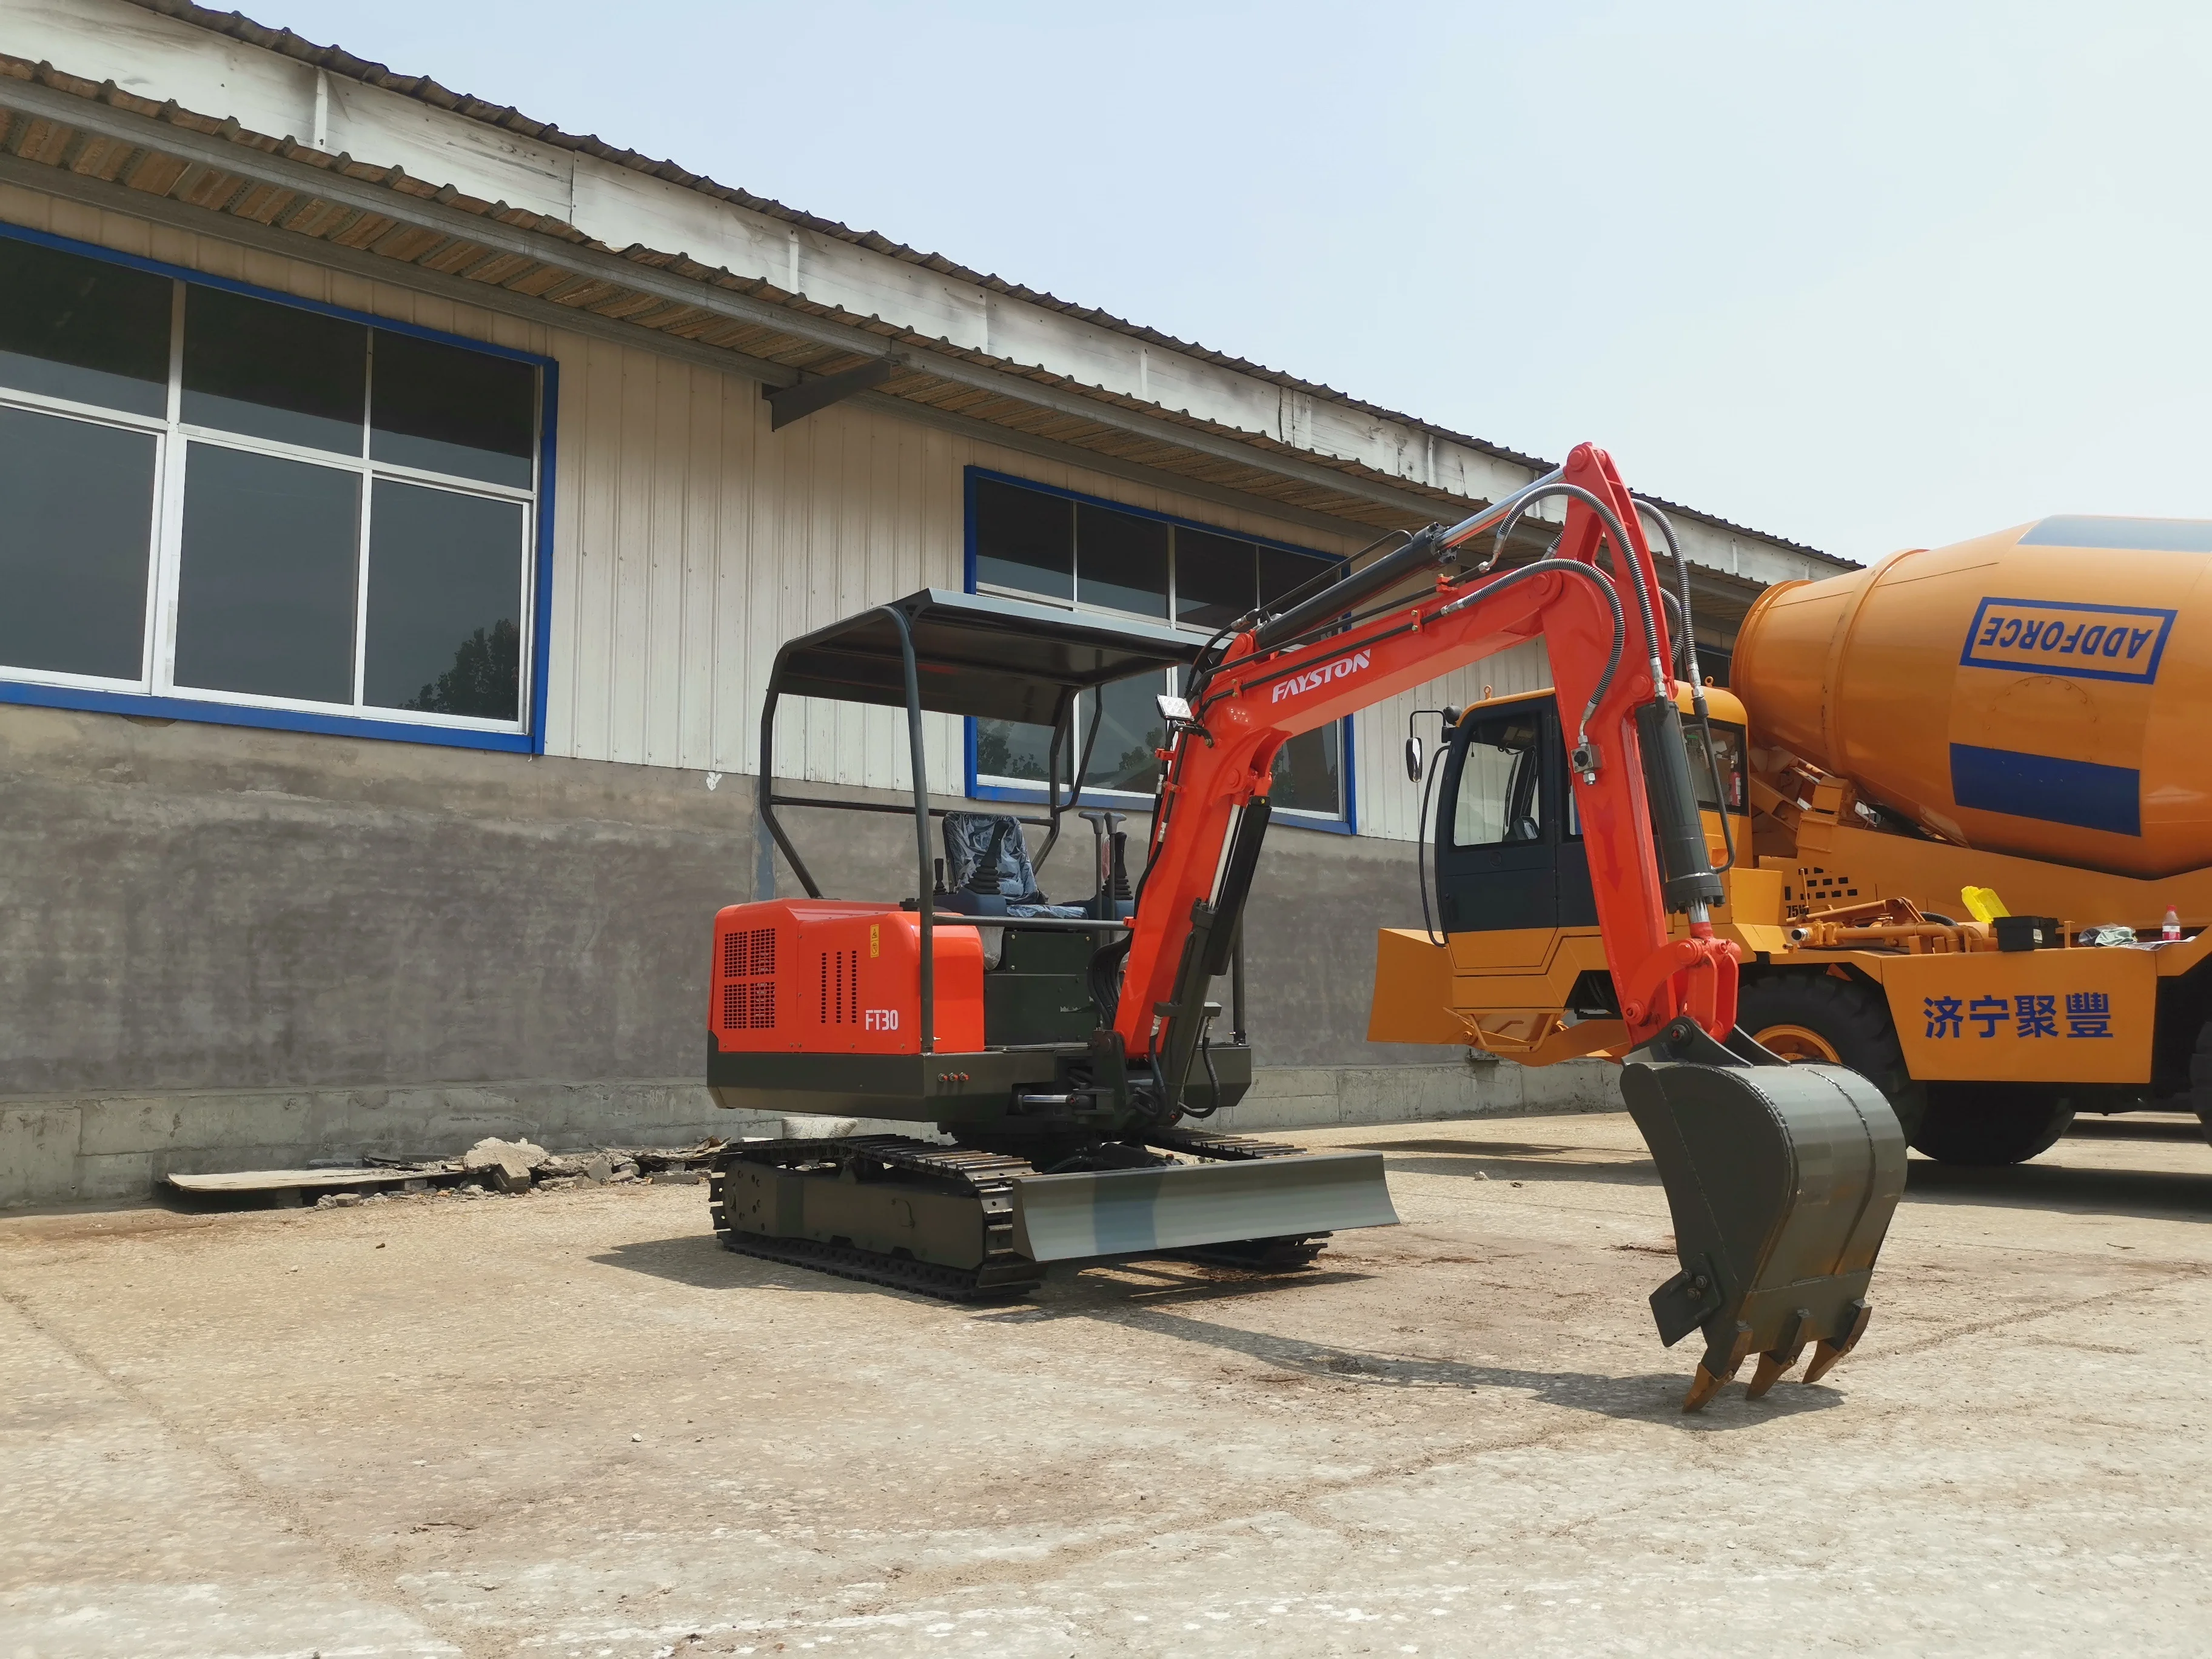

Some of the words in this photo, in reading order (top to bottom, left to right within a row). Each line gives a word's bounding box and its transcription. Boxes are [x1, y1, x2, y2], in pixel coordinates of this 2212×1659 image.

[1979, 617, 2154, 659] ADDFORCE
[1272, 649, 1371, 703] FAYSTON
[865, 1010, 899, 1030] FT30
[1923, 992, 2114, 1039] 济宁聚豐
